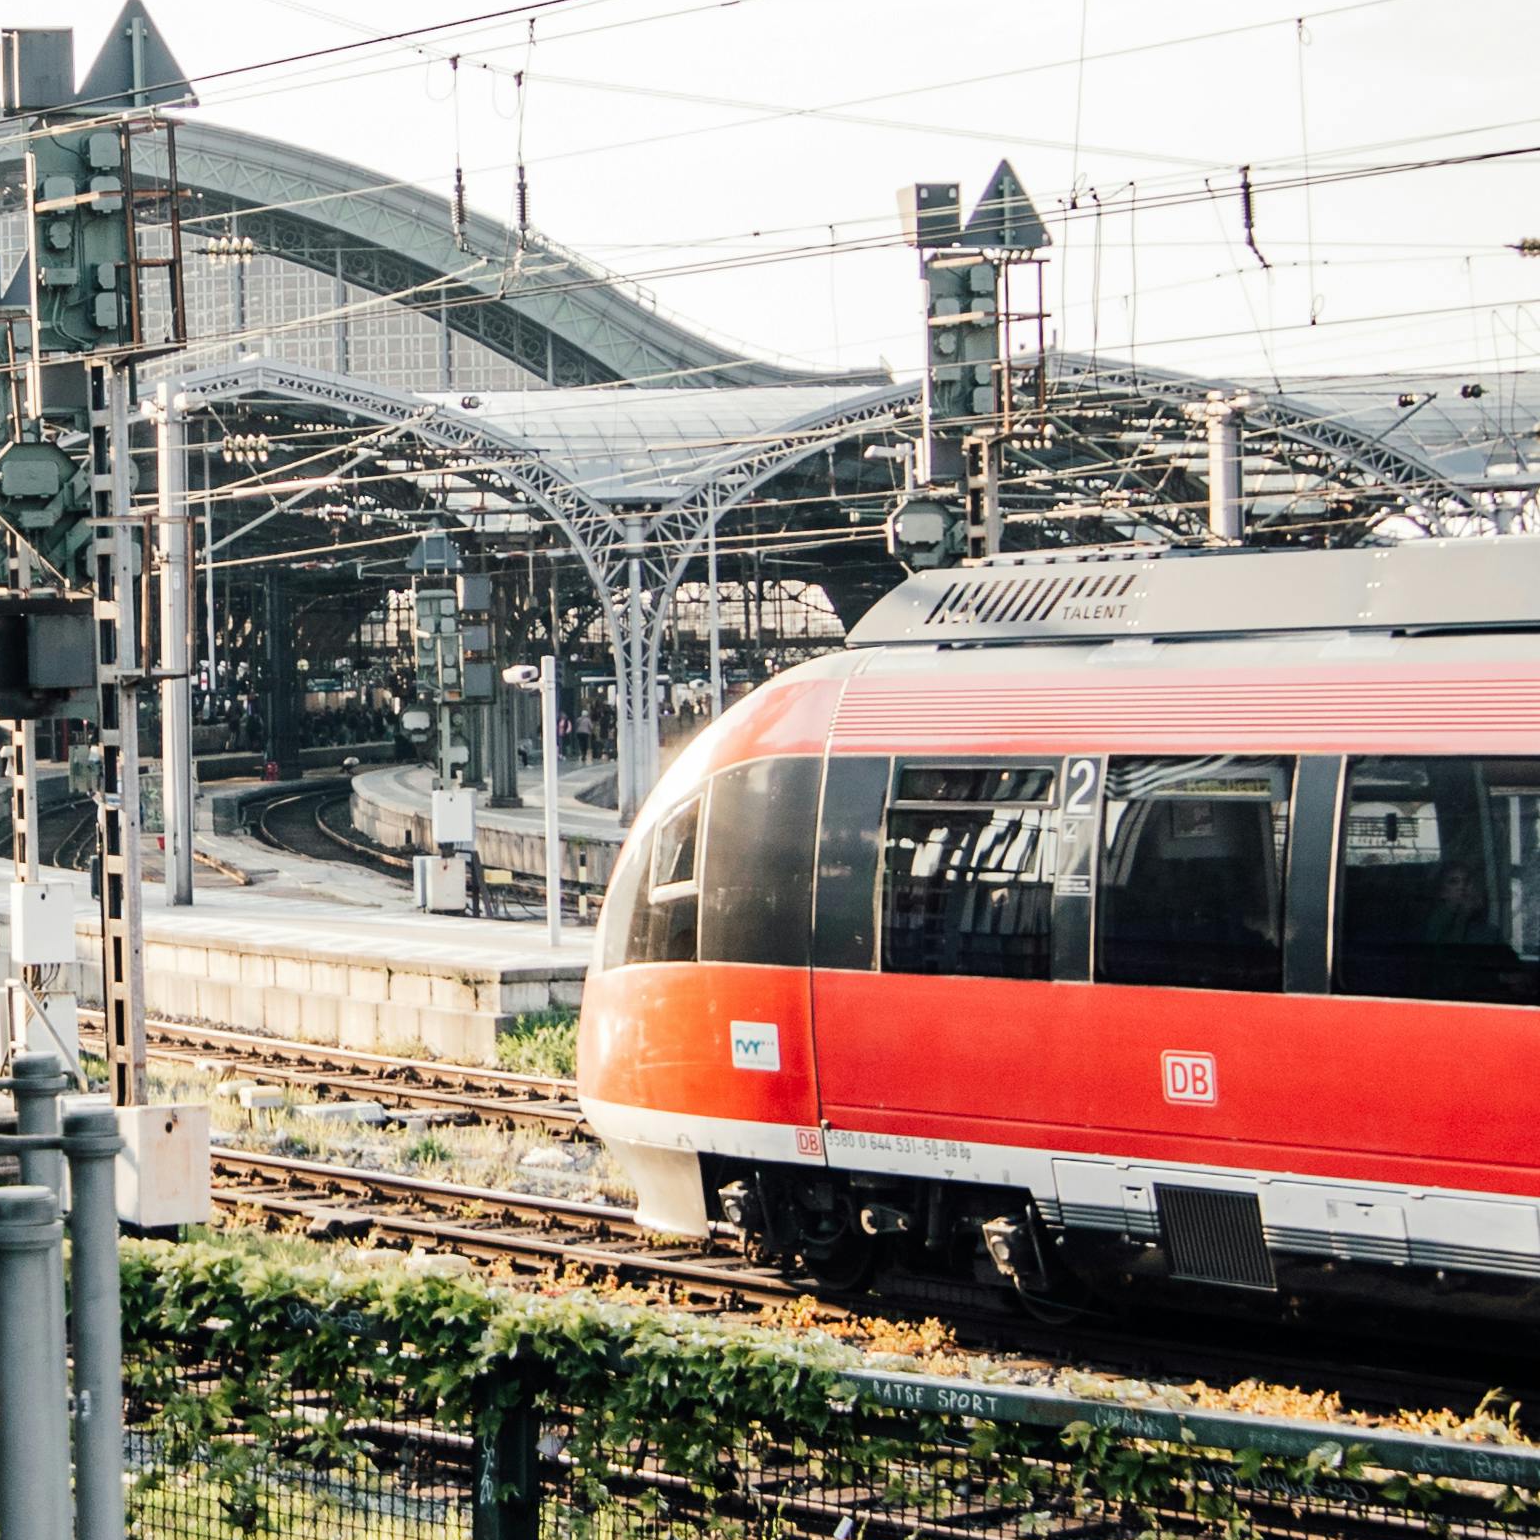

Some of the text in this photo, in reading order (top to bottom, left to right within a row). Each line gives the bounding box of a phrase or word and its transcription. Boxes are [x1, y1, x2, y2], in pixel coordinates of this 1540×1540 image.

[1063, 603, 1129, 620] TALENT
[1066, 759, 1096, 814] 2
[1170, 1061, 1209, 1096] DB
[798, 1131, 820, 1152] DB
[937, 1388, 999, 1414] SPORT
